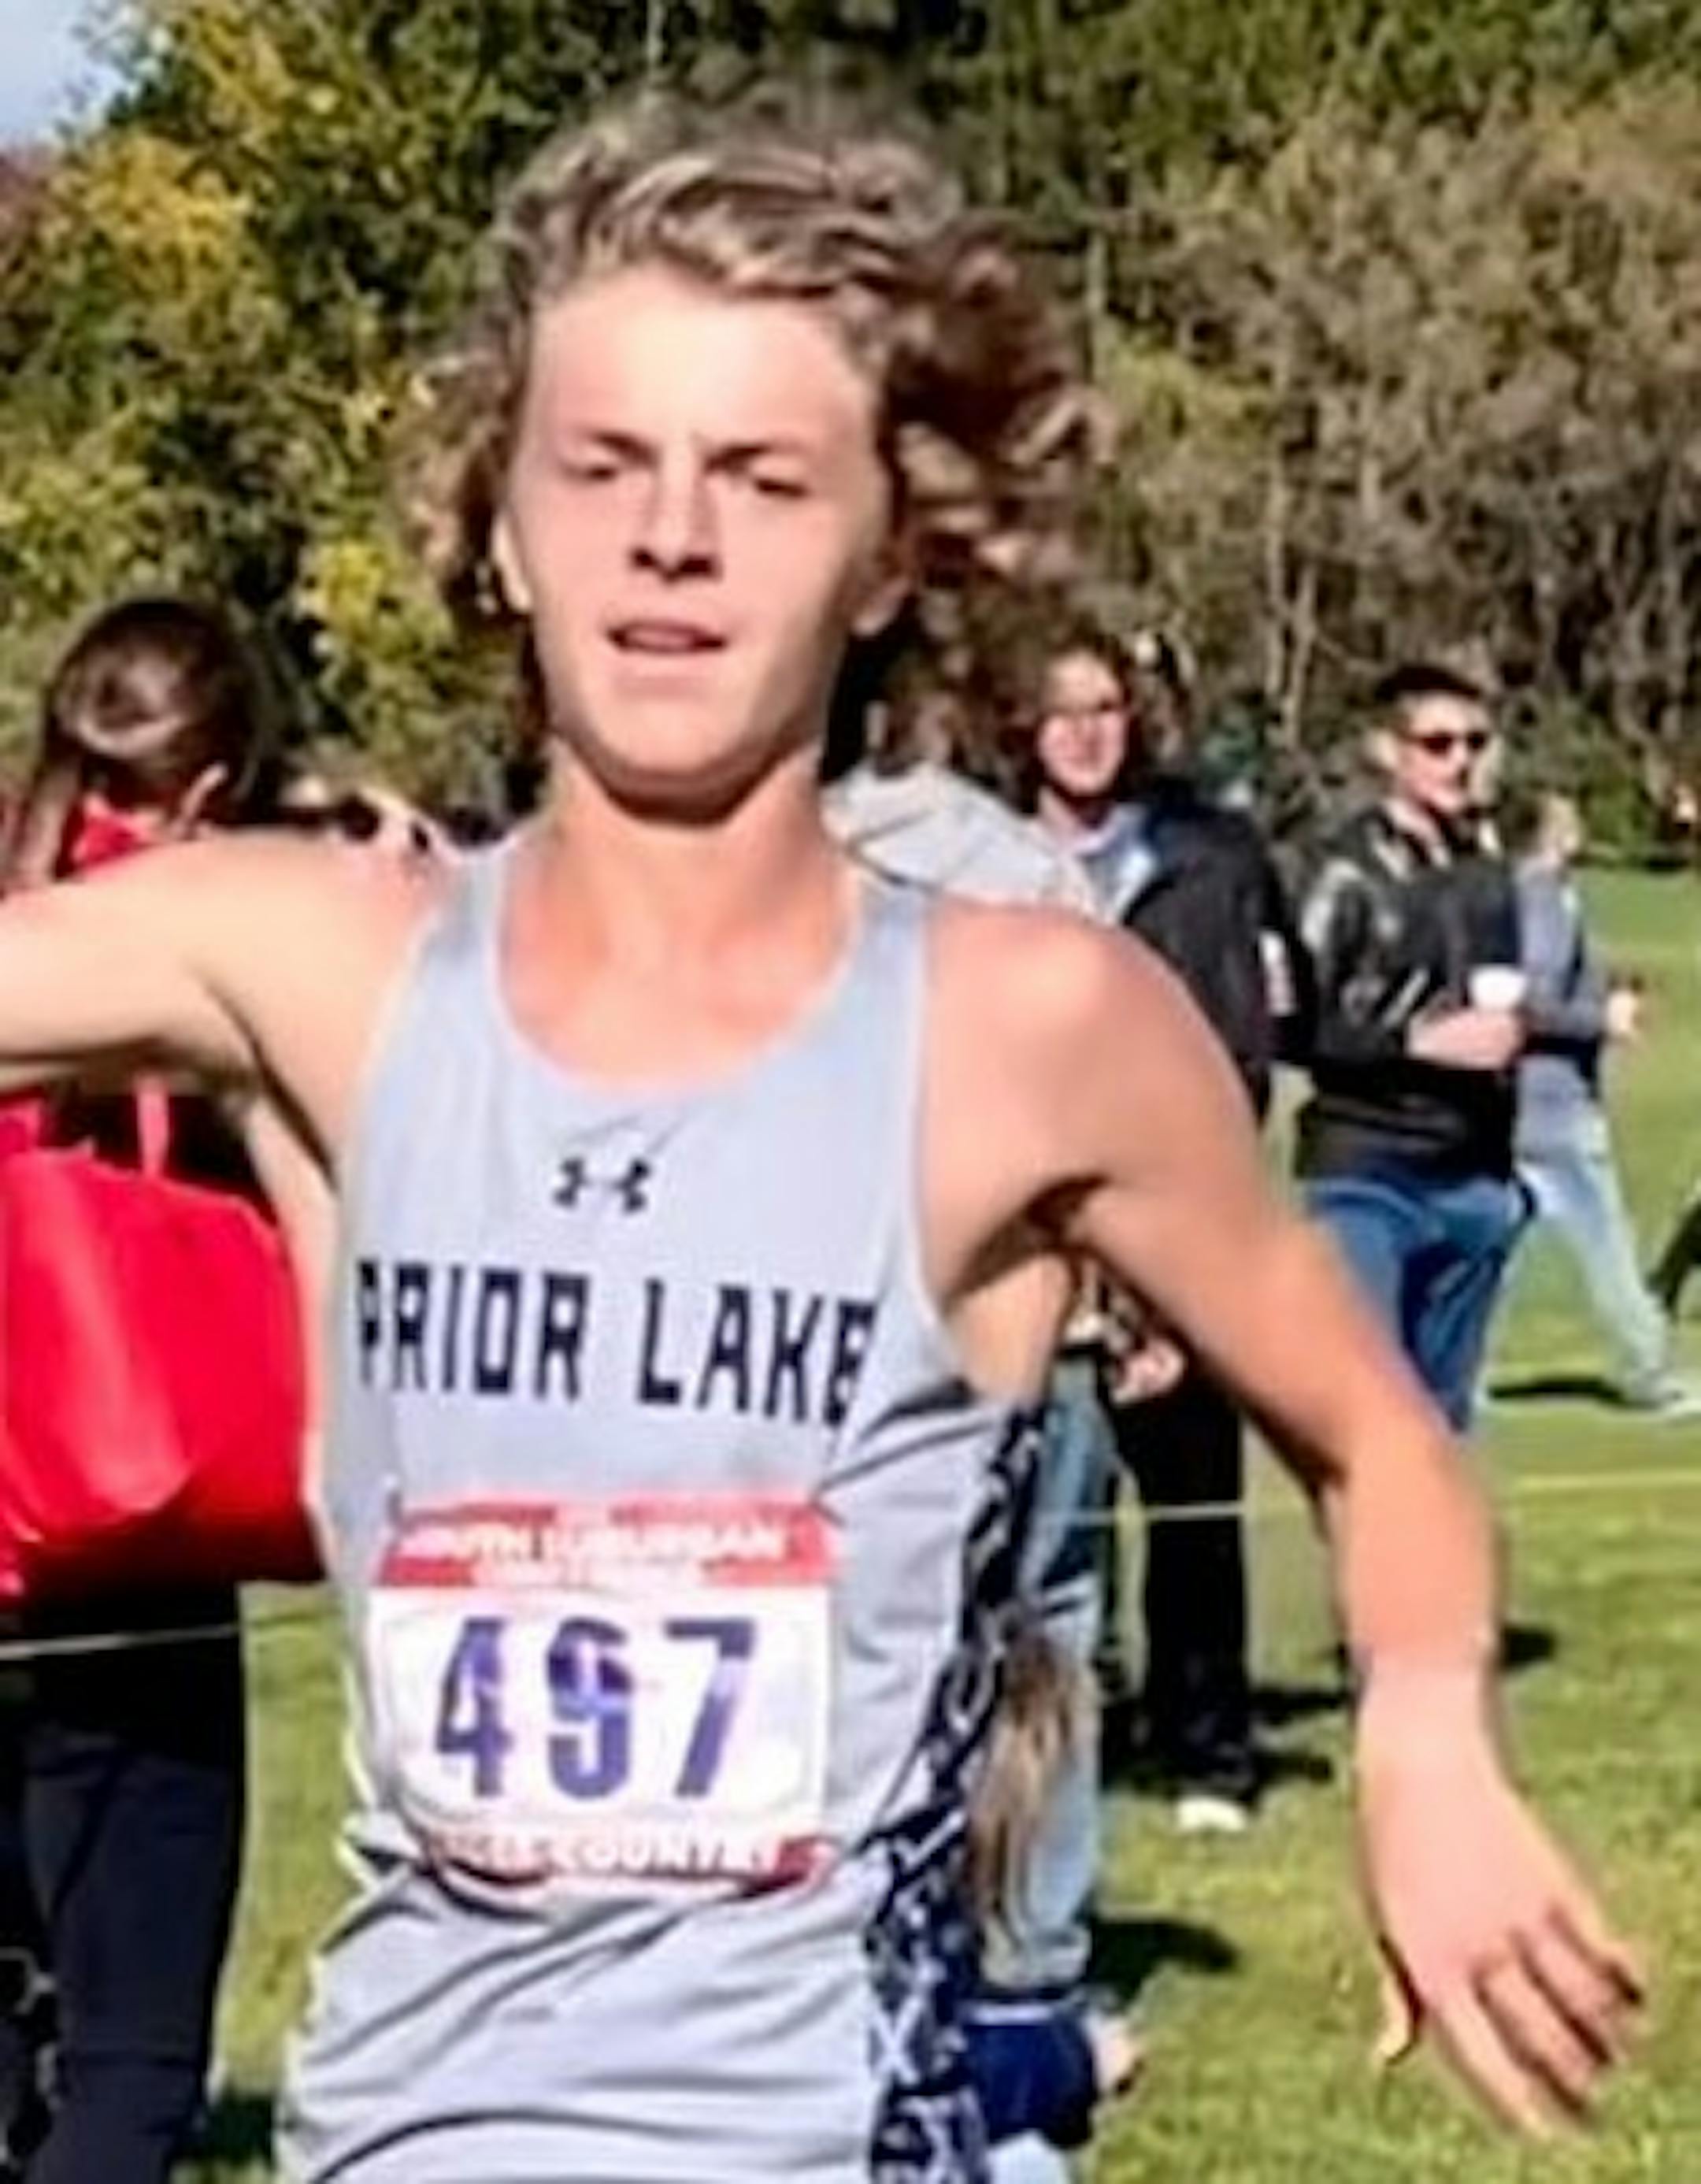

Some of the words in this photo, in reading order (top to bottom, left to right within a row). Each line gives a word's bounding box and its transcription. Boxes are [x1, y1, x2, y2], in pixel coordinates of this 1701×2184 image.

[357, 1258, 591, 1403] PRIOR
[636, 1277, 876, 1427] LAKE
[435, 1617, 756, 1800] 497
